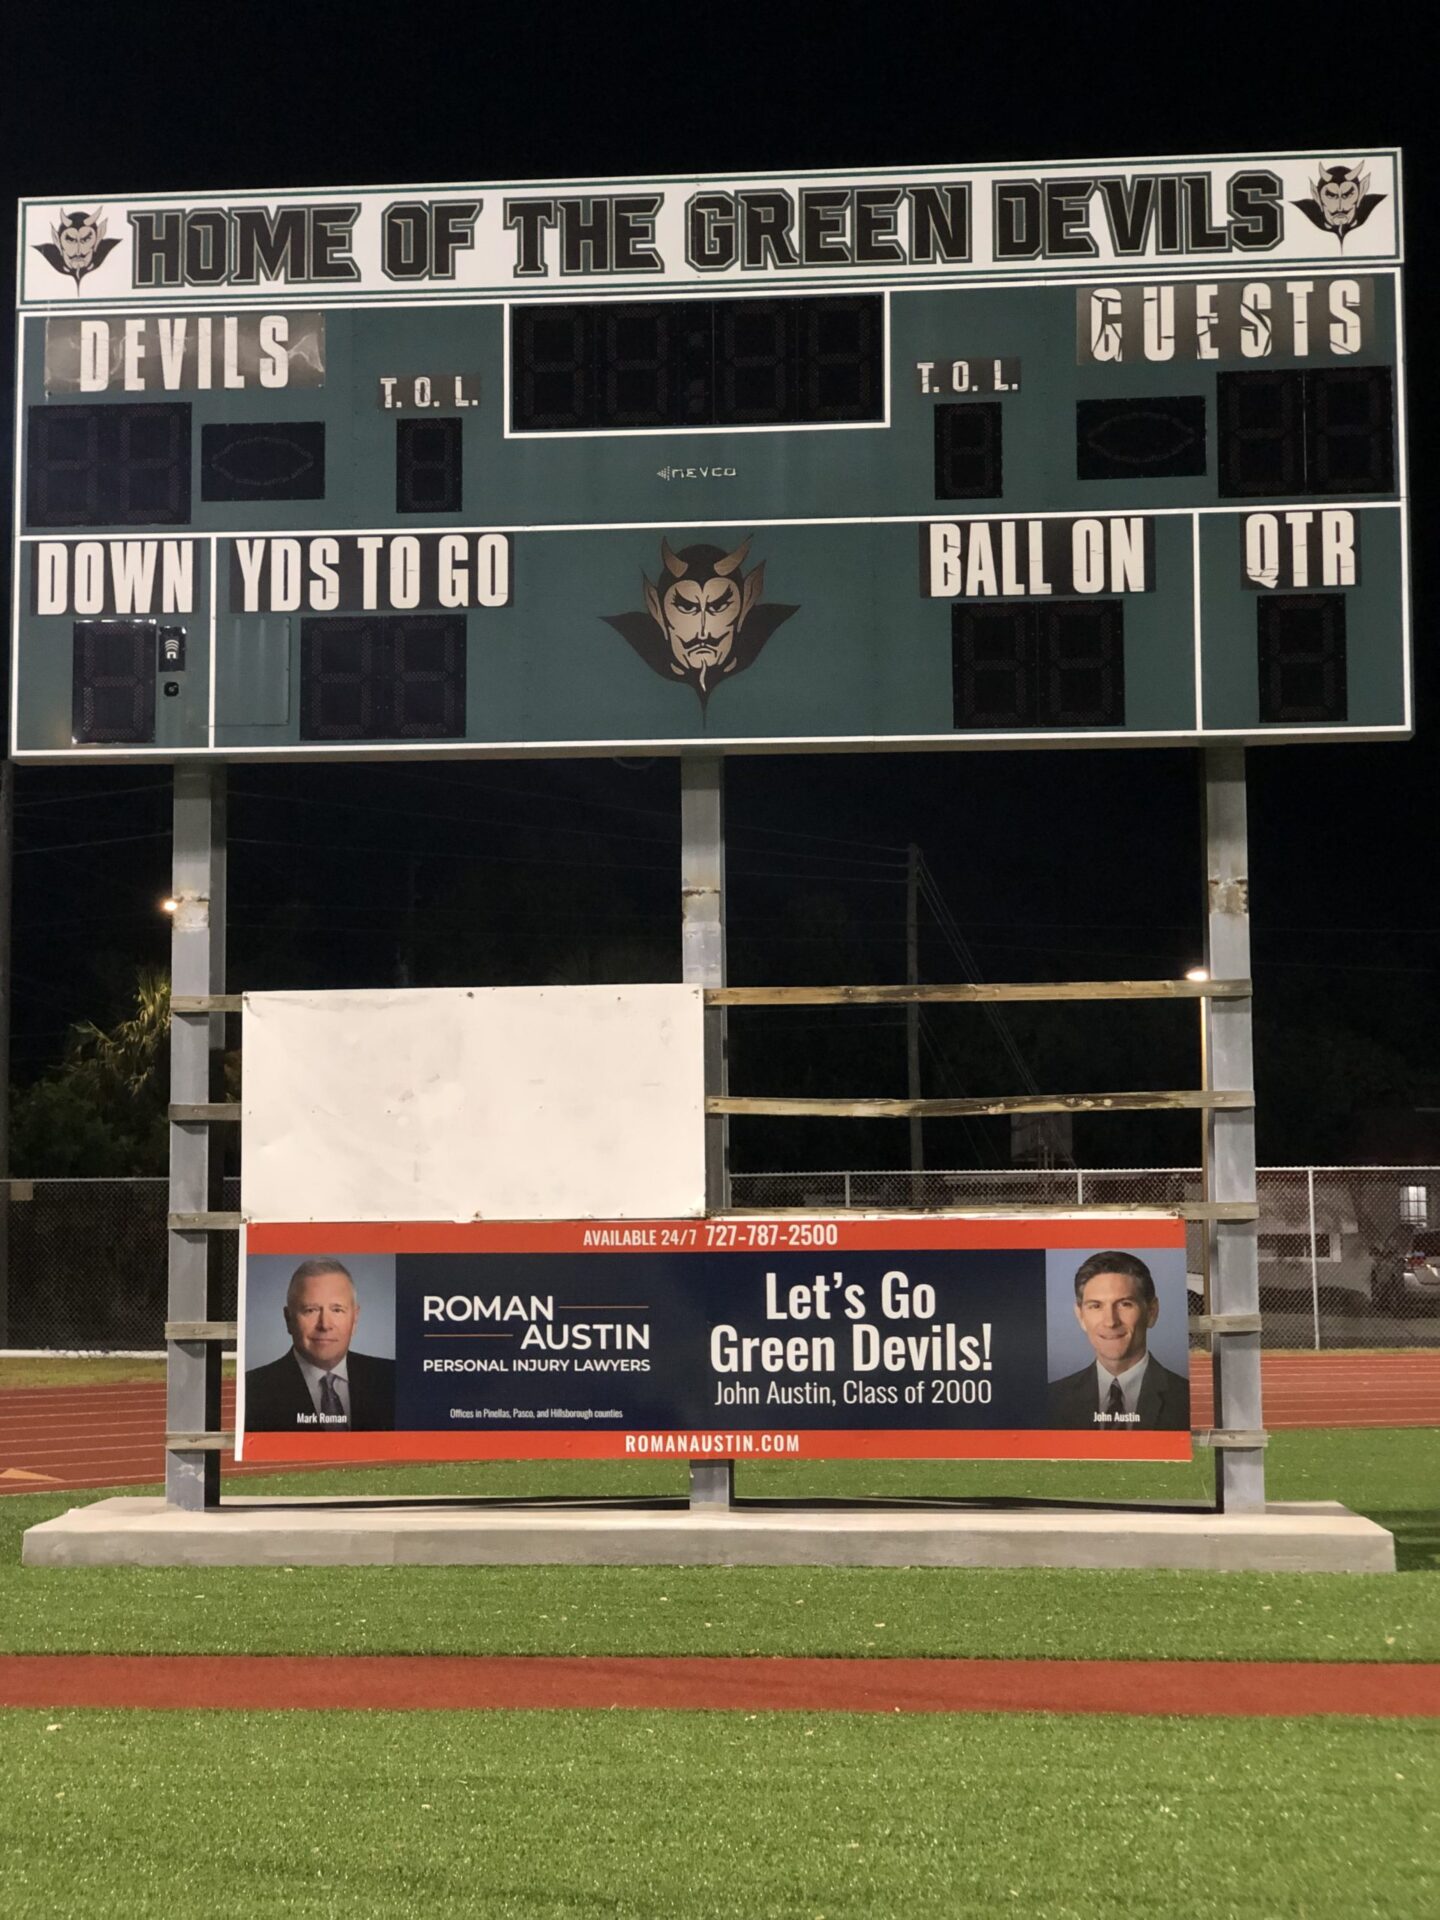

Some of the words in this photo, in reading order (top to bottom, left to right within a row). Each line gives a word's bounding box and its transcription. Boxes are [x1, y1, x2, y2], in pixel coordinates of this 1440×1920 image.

[127, 202, 362, 289] HOME
[381, 199, 484, 281] OF
[503, 193, 666, 278] THE
[685, 180, 972, 272] GREEN
[992, 169, 1284, 262] DEVILS
[1091, 279, 1362, 361] GUESTS
[79, 315, 290, 392] DEVILS
[929, 520, 1053, 597] BALL
[1072, 517, 1145, 594] ON
[1245, 509, 1357, 590] QTR
[37, 540, 194, 615] DOWN
[235, 537, 341, 612] YDS
[357, 536, 421, 610] TO
[438, 534, 510, 608] GO
[583, 1229, 657, 1246] AVAILABLE
[661, 1228, 698, 1246] 24/7
[705, 1223, 839, 1247] 727-787-2500
[423, 1295, 554, 1322] ROMAN
[766, 1271, 867, 1320] Let's
[881, 1270, 937, 1320] Go
[520, 1324, 650, 1350] AUSTIN
[710, 1324, 836, 1373] Green
[852, 1323, 993, 1372] Devils!
[423, 1359, 508, 1372] PERSONAL
[513, 1359, 570, 1372] INJURY
[574, 1359, 650, 1372] LAWYERS
[714, 1381, 760, 1406] John
[766, 1381, 837, 1407] Austin,
[842, 1380, 899, 1404] Class
[904, 1380, 926, 1404] of
[931, 1379, 992, 1404] 2000
[296, 1413, 318, 1423] Mark
[319, 1412, 348, 1423] Roman
[450, 1408, 474, 1418] Offices
[475, 1408, 482, 1418] in
[513, 1408, 536, 1419] Pasco,
[537, 1408, 549, 1418] and
[550, 1408, 593, 1420] Hillsborough
[594, 1408, 623, 1418] counties
[1093, 1411, 1112, 1422] John
[1114, 1411, 1140, 1422] Austin
[625, 1434, 800, 1453] ROMANAUSTIN.COM
